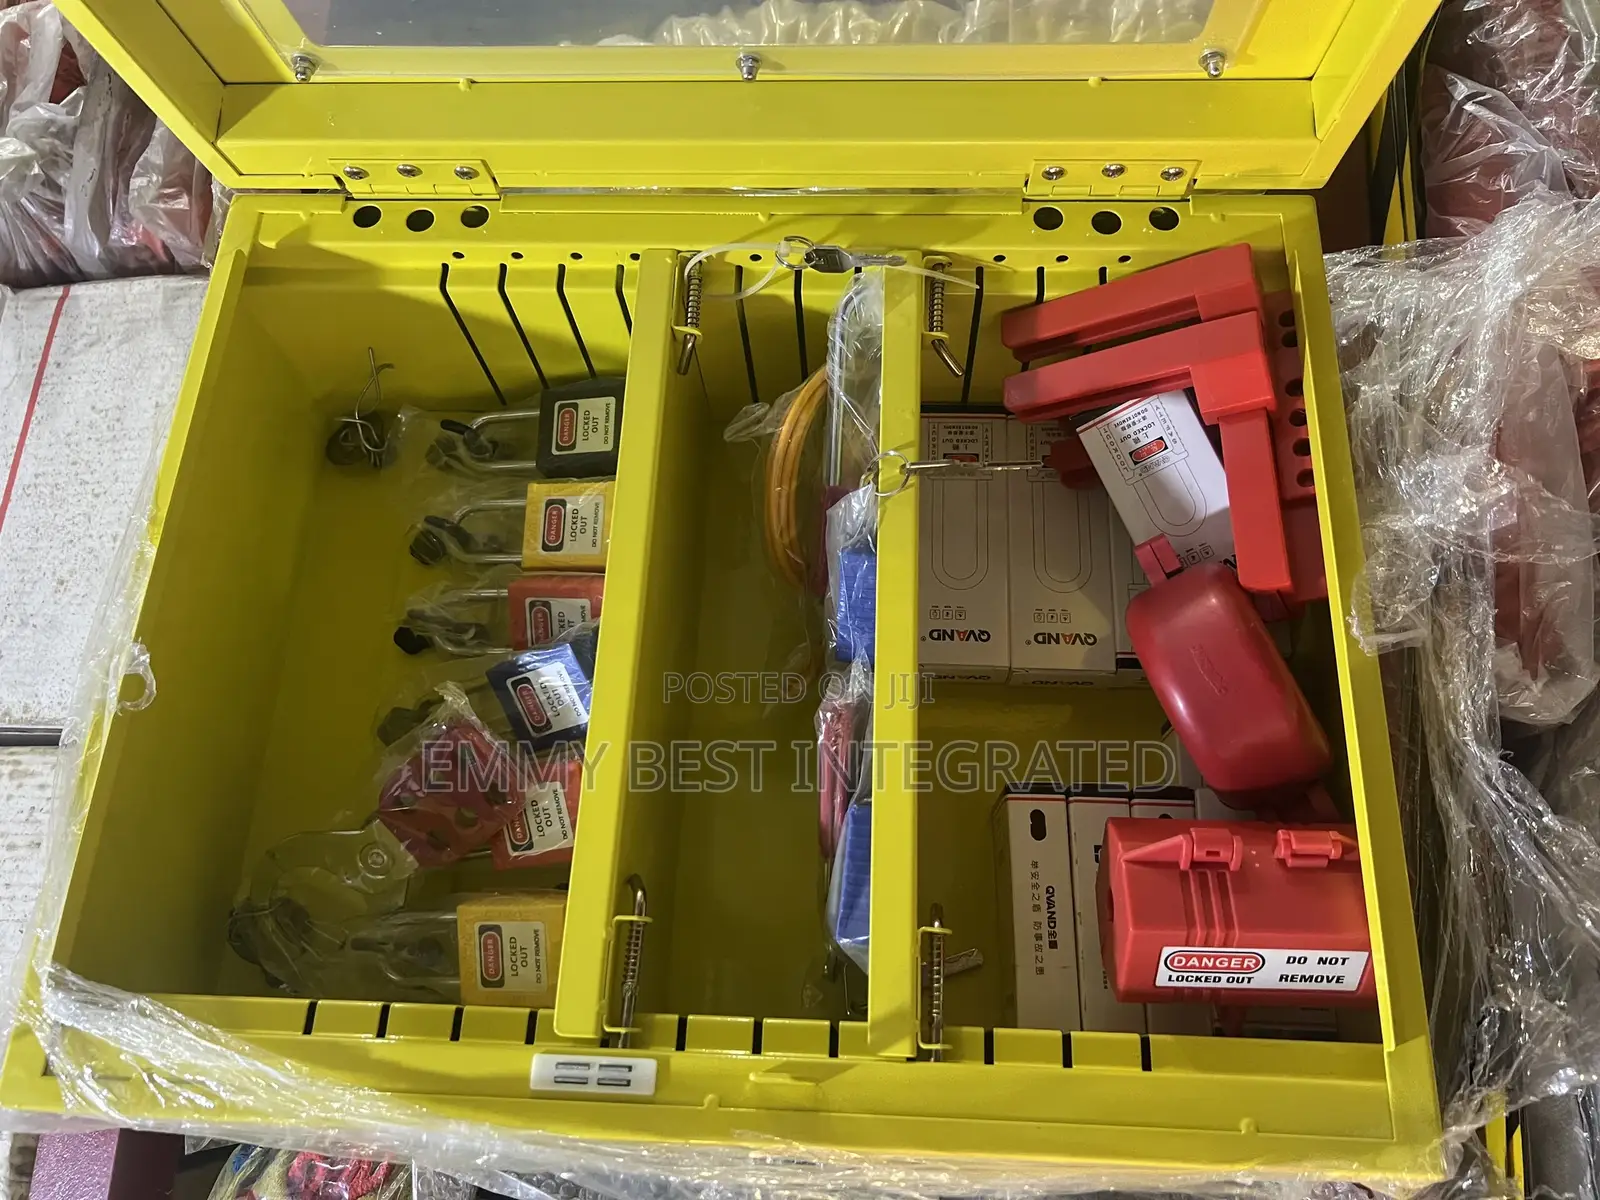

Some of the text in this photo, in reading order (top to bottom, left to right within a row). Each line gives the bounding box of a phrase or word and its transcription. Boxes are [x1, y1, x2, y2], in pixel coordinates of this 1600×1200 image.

[582, 410, 590, 441] LOCKED
[591, 416, 599, 433] OUT
[1119, 421, 1156, 443] LOCKED OUT
[603, 436, 609, 445] DO
[549, 510, 558, 541] DANGER
[570, 508, 579, 542] LOCKED
[580, 516, 588, 534] OUT
[591, 539, 597, 547] DO
[928, 629, 991, 643] QVAND
[1033, 632, 1098, 646] QVAND
[530, 800, 546, 837] LOCKED
[542, 807, 553, 827] OUT
[552, 788, 568, 840] DO NOT REMOVE
[533, 928, 541, 957] REMOVE
[486, 939, 496, 975] DANGER
[509, 936, 519, 976] LOCKED
[520, 946, 528, 968] OUT
[1172, 956, 1257, 968] DANGER
[1285, 956, 1350, 966] DO NOT
[536, 973, 542, 984] DO
[1167, 974, 1254, 984] LOCKED OUT
[1278, 974, 1345, 984] REMOVE
